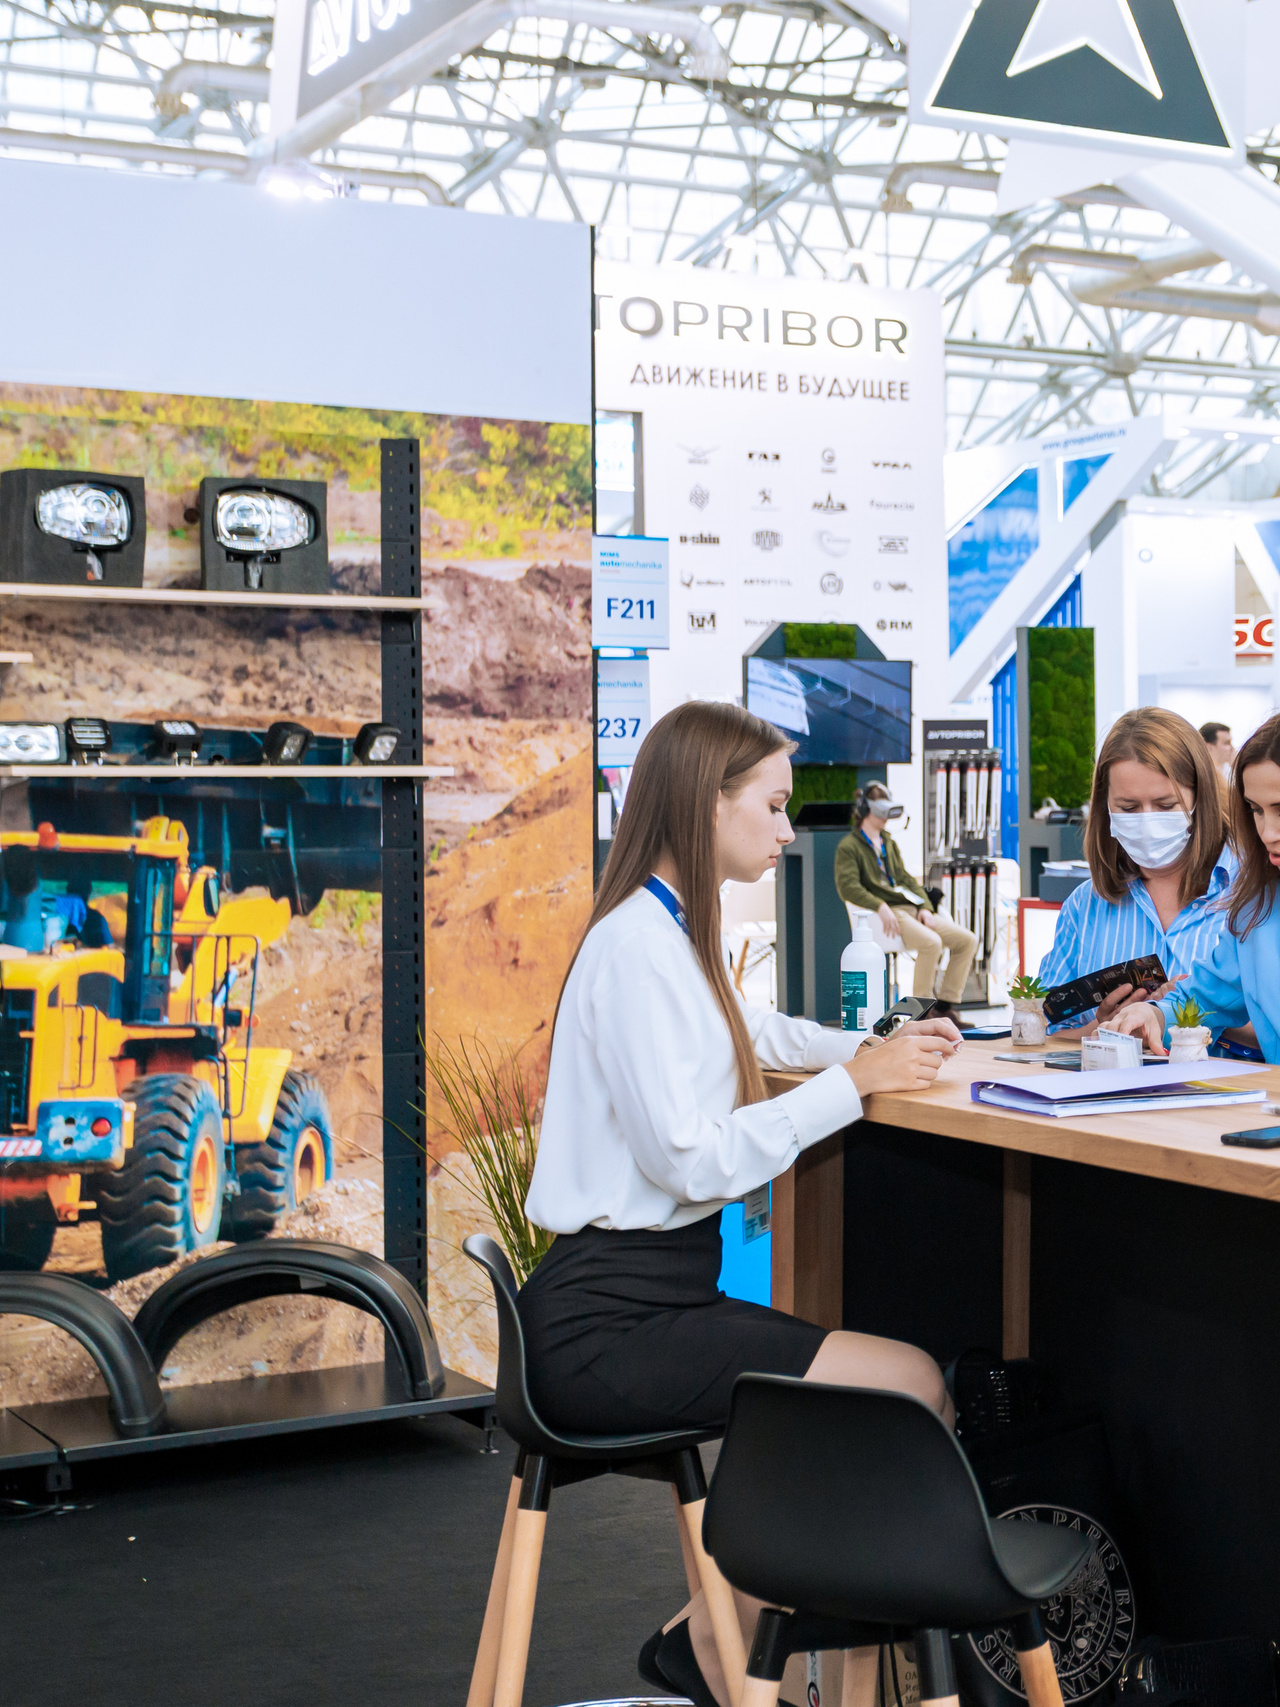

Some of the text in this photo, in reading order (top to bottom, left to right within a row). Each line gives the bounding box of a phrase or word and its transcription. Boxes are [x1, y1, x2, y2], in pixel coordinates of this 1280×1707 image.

[630, 363, 910, 402] ДВИЖЕНИЕ В БУДУЩЕЕ
[599, 560, 662, 570] automechanika
[606, 597, 656, 621] F211
[598, 717, 641, 739] 237
